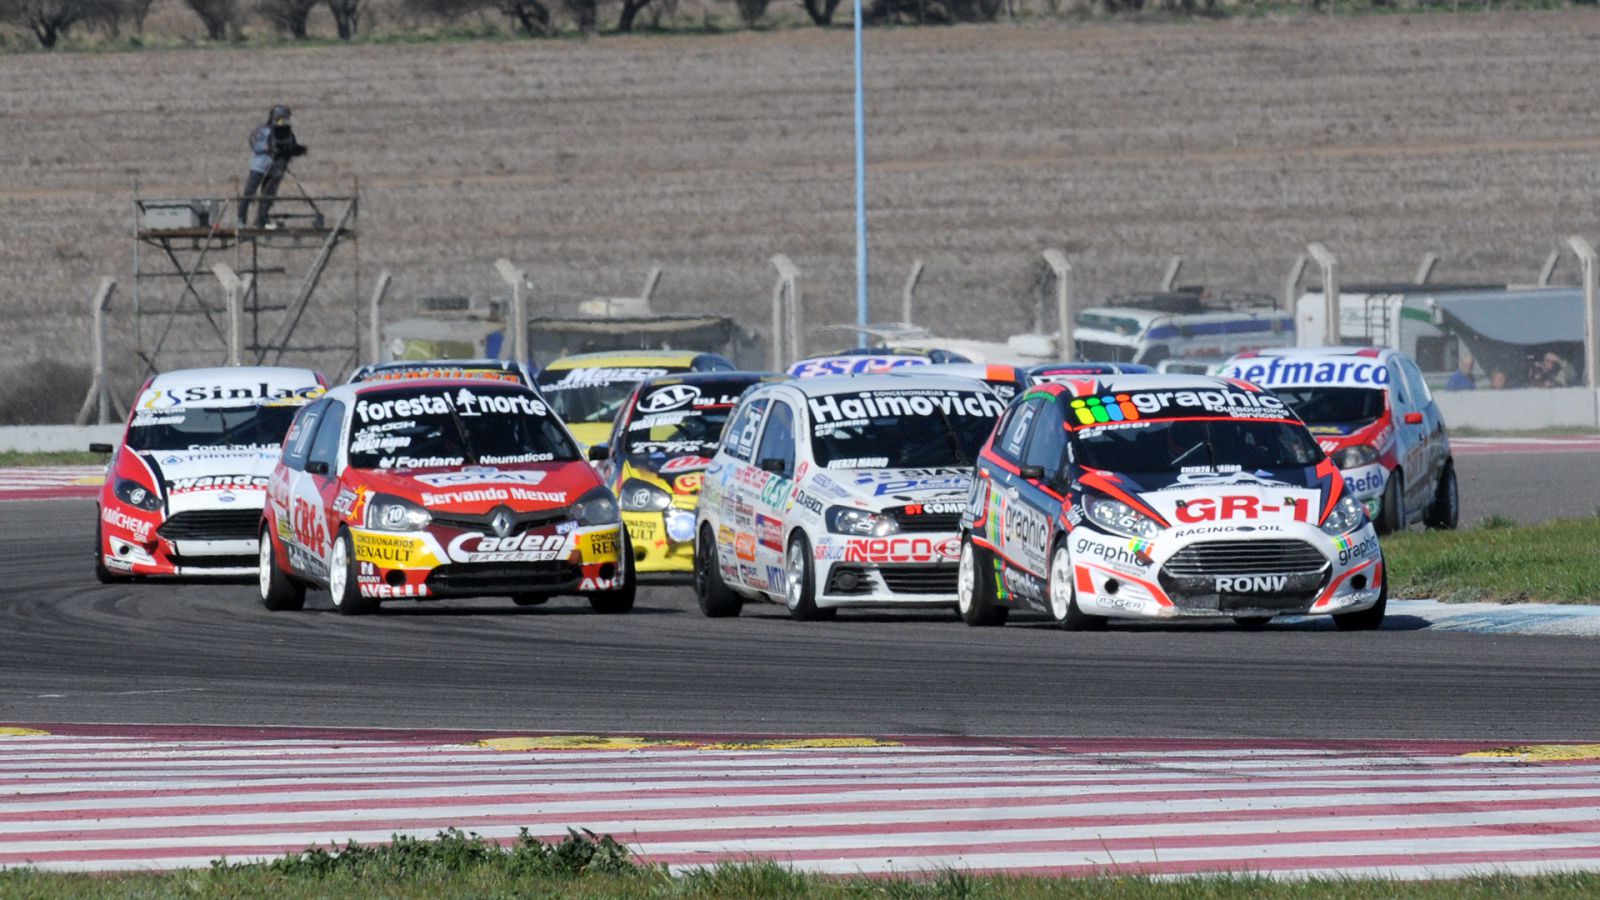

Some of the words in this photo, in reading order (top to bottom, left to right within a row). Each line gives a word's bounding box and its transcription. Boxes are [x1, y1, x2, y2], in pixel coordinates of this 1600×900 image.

[357, 392, 455, 422] forestal
[479, 395, 547, 417] norte
[808, 391, 1004, 423] Haimovich
[1131, 390, 1285, 414] graphic
[1209, 405, 1289, 416] Outsourcing
[480, 452, 554, 465] Neumaticos
[429, 472, 528, 485] TOTAL
[421, 487, 509, 506] Servando
[510, 487, 567, 503] Menor
[389, 506, 405, 522] 10
[1175, 495, 1309, 524] GR-1
[1005, 504, 1047, 553] graphic
[1175, 526, 1235, 538] RACING
[356, 544, 412, 562] RENAULT
[469, 553, 555, 562] BATERIAS
[1076, 538, 1147, 568] graphic
[1339, 535, 1378, 566] graphic
[361, 583, 428, 598] AVELLI
